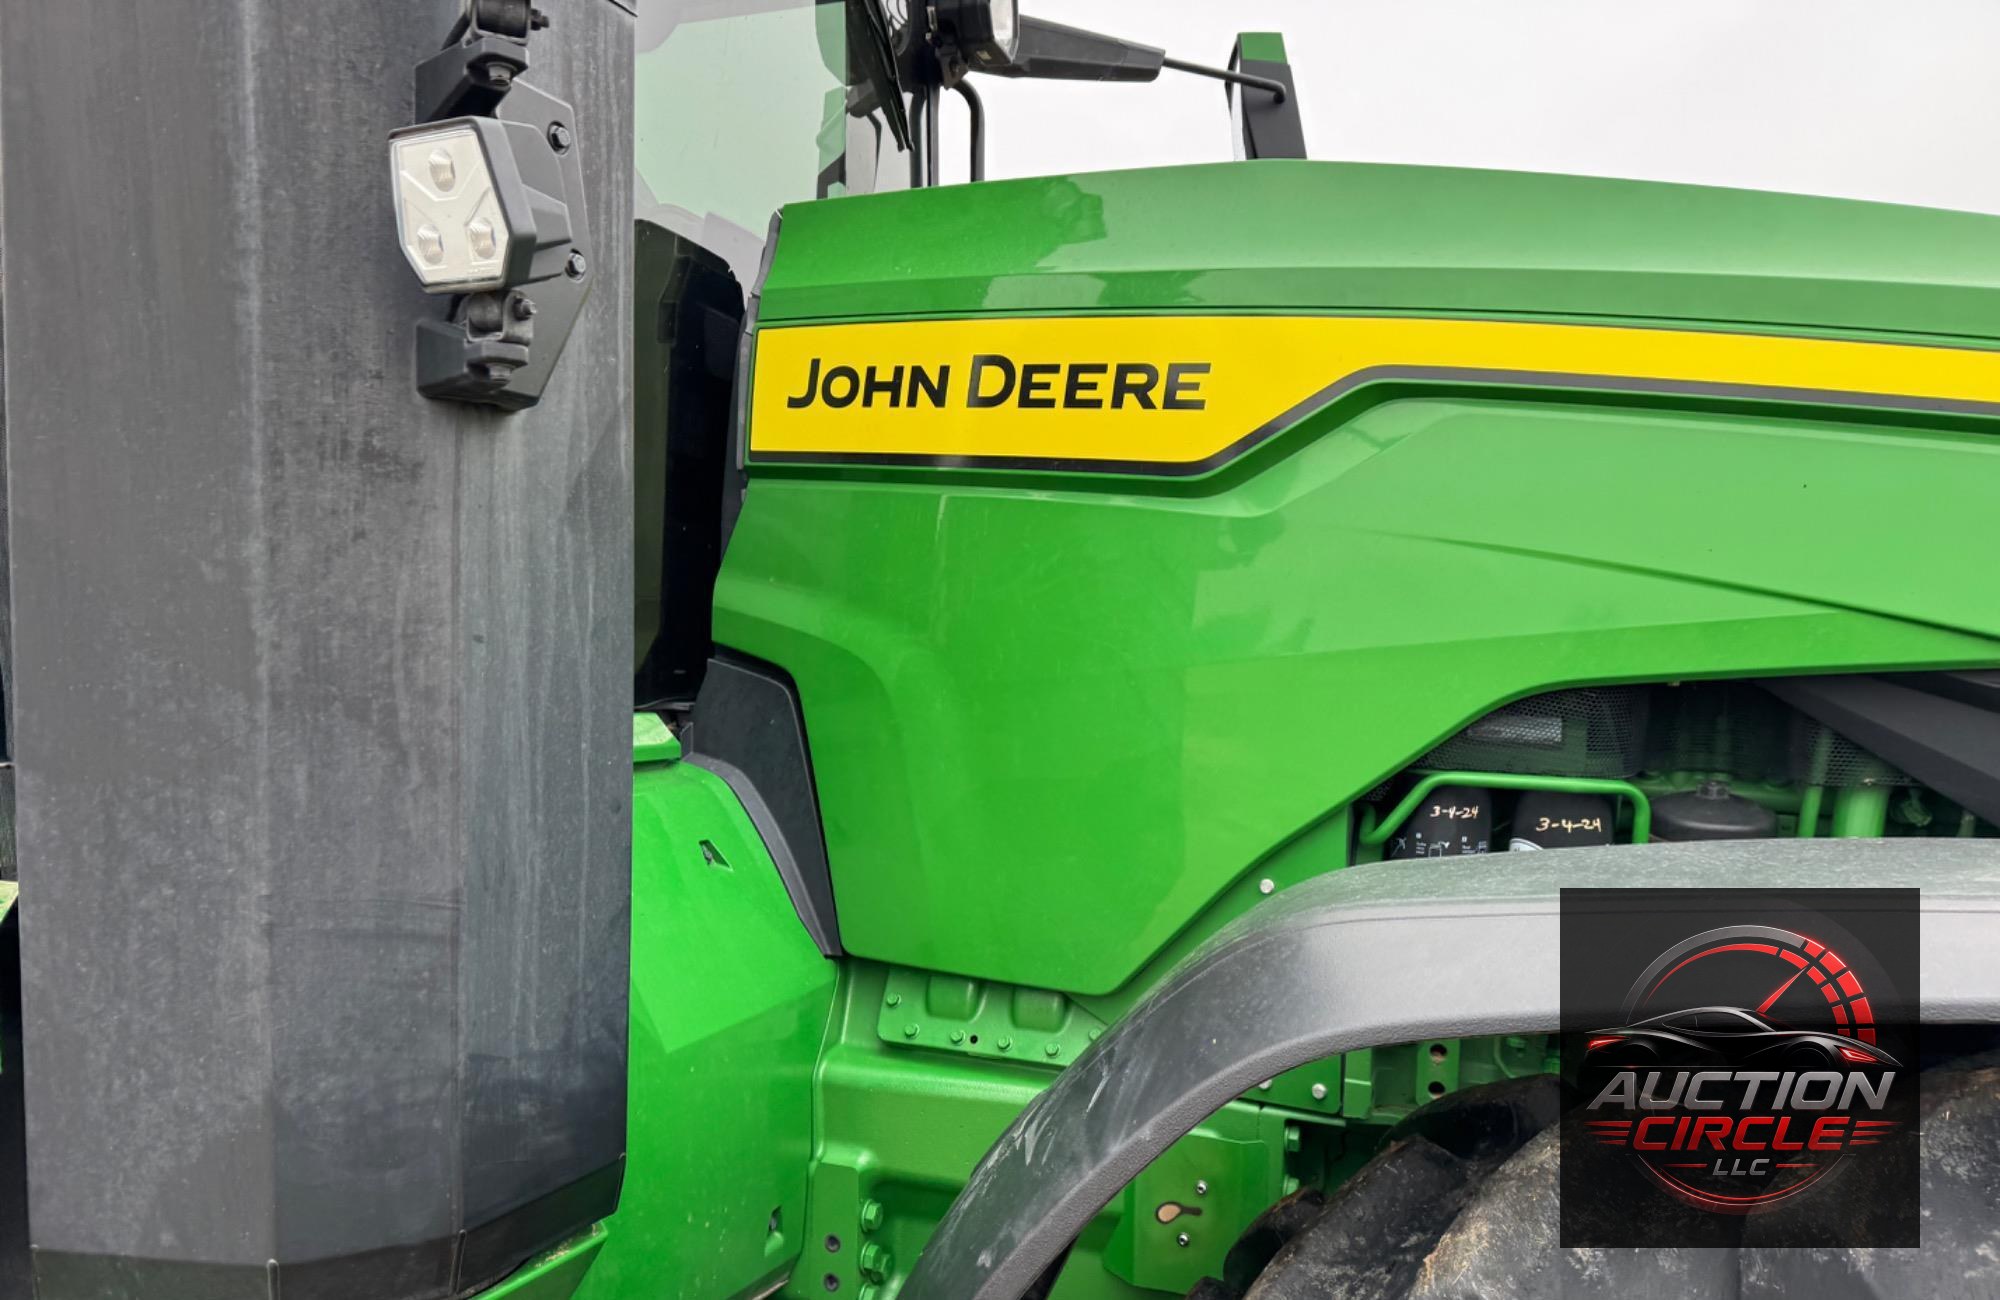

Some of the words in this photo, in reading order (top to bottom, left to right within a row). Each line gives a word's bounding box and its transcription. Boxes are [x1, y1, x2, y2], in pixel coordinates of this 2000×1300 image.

[787, 358, 950, 408] JOHN
[966, 354, 1211, 410] DEERE
[1430, 805, 1479, 819] 3-4-24
[1535, 817, 1602, 832] 3-4-24
